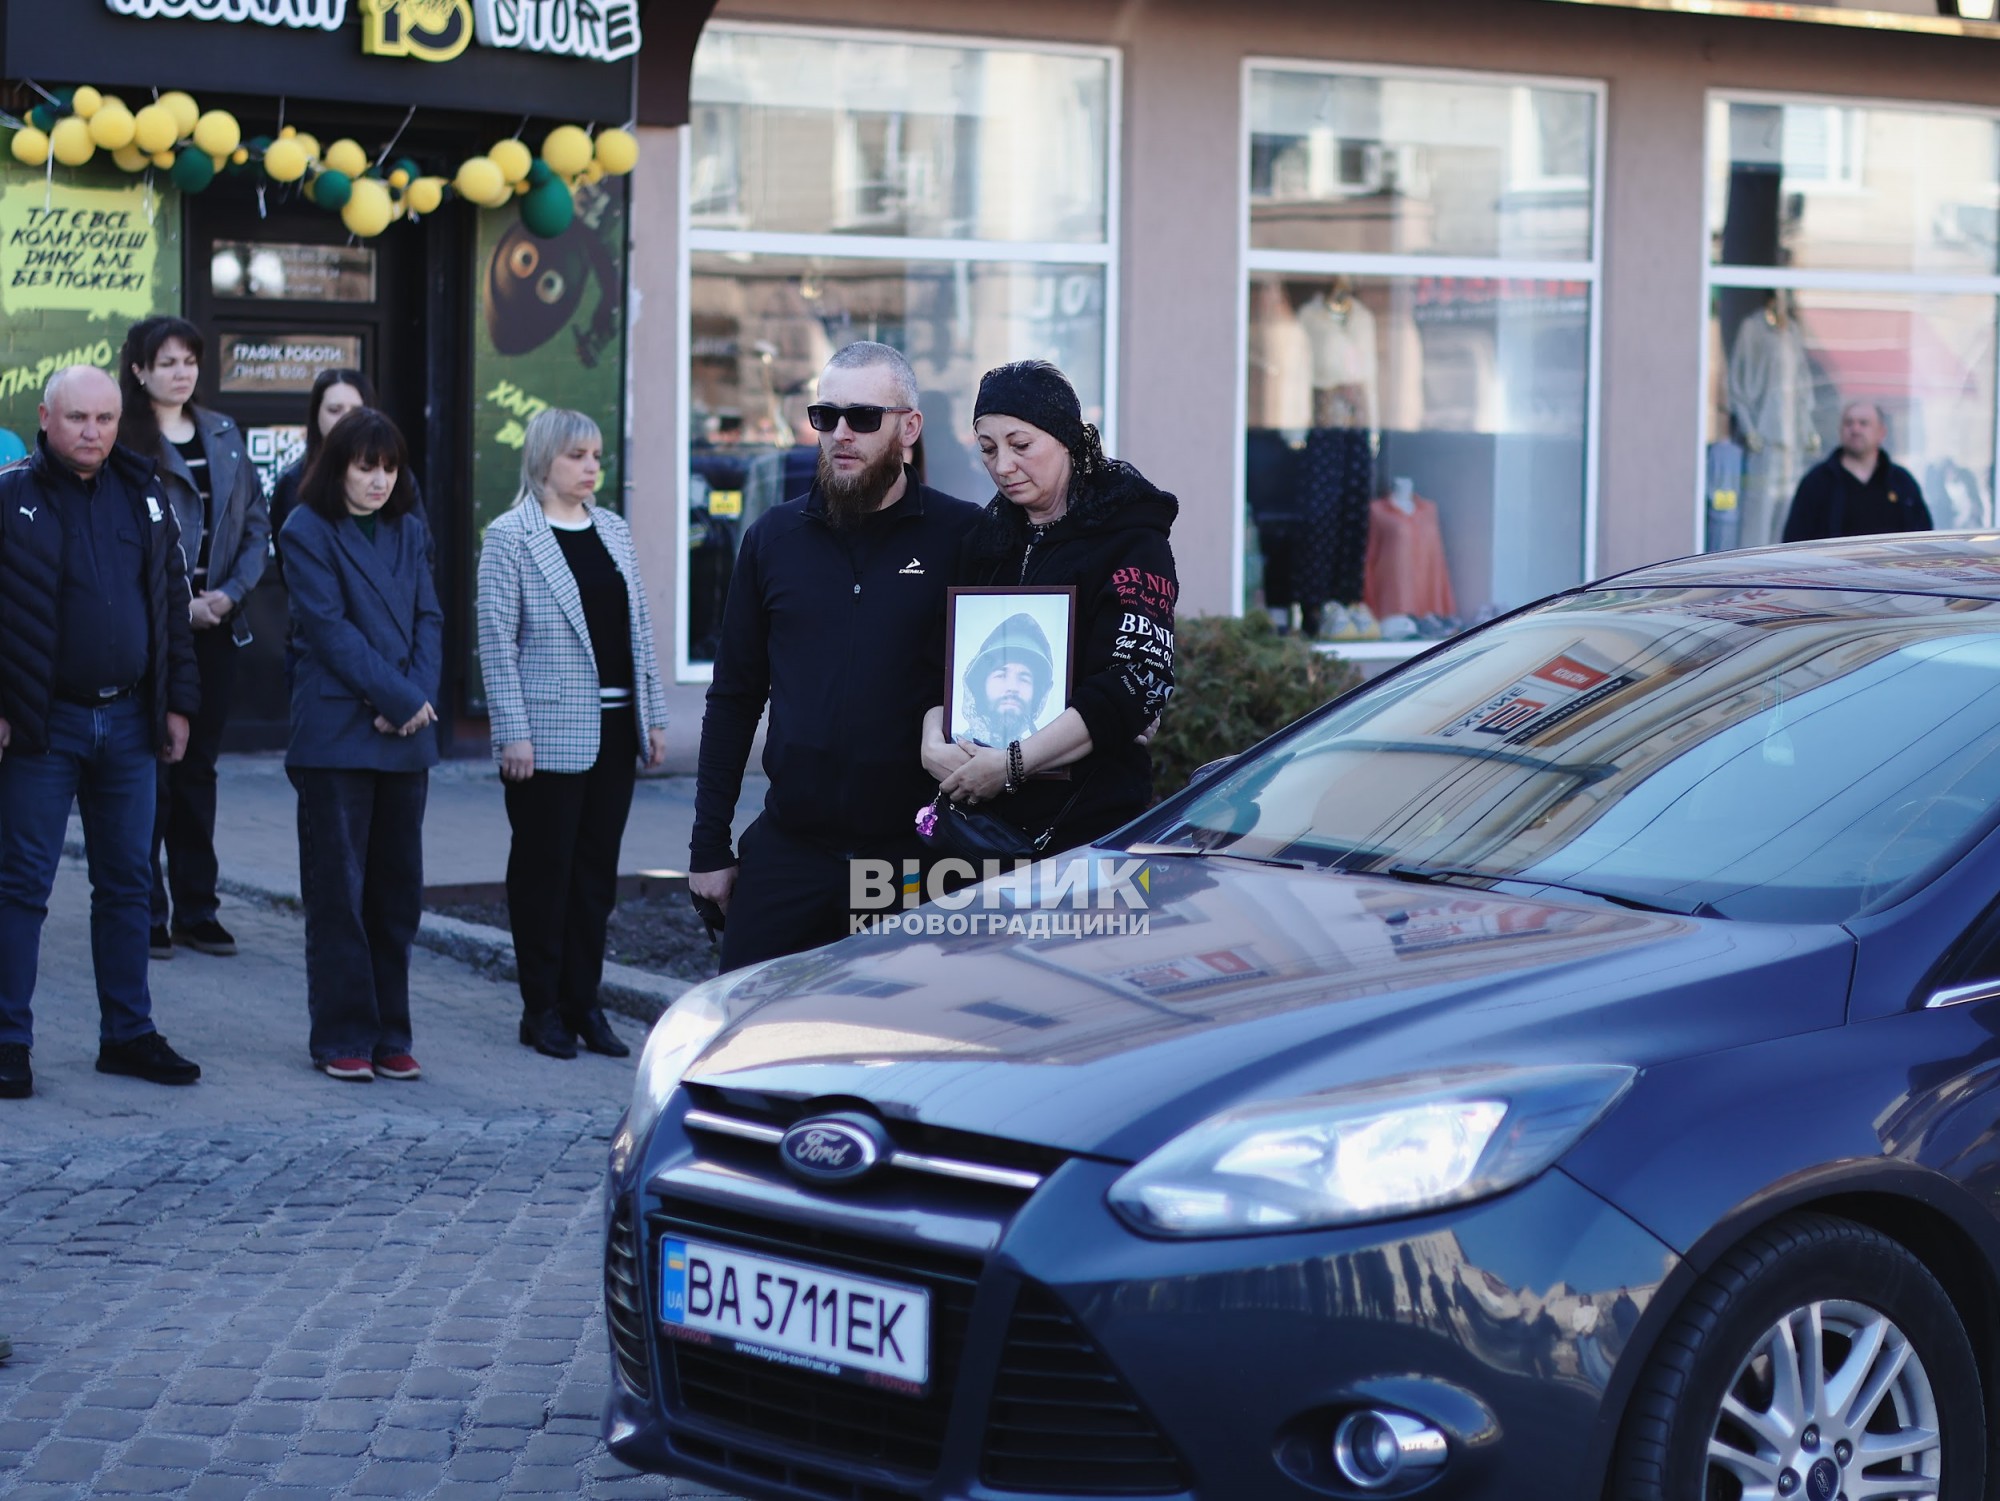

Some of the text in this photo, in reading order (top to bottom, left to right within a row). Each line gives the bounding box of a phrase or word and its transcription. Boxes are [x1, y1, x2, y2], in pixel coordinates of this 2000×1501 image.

[28, 208, 68, 226] ТУТ
[89, 210, 130, 228] ВСЕ
[10, 229, 148, 249] КОЛИ ХОЧЕШ
[93, 252, 133, 268] АЛЕ
[11, 270, 53, 287] БЕЗ
[233, 343, 283, 361] ГРАФІК
[1113, 567, 1142, 585] BE
[1117, 585, 1136, 596] Get
[1119, 613, 1152, 636] BE
[1112, 651, 1131, 660] Drink
[1116, 636, 1137, 650] Get
[1139, 640, 1162, 656] Lost
[796, 1129, 851, 1166] Ford
[667, 1291, 684, 1310] UA
[688, 1257, 907, 1363] BA 5711 EK
[735, 1341, 840, 1375] www.toyota-zentrum.de
